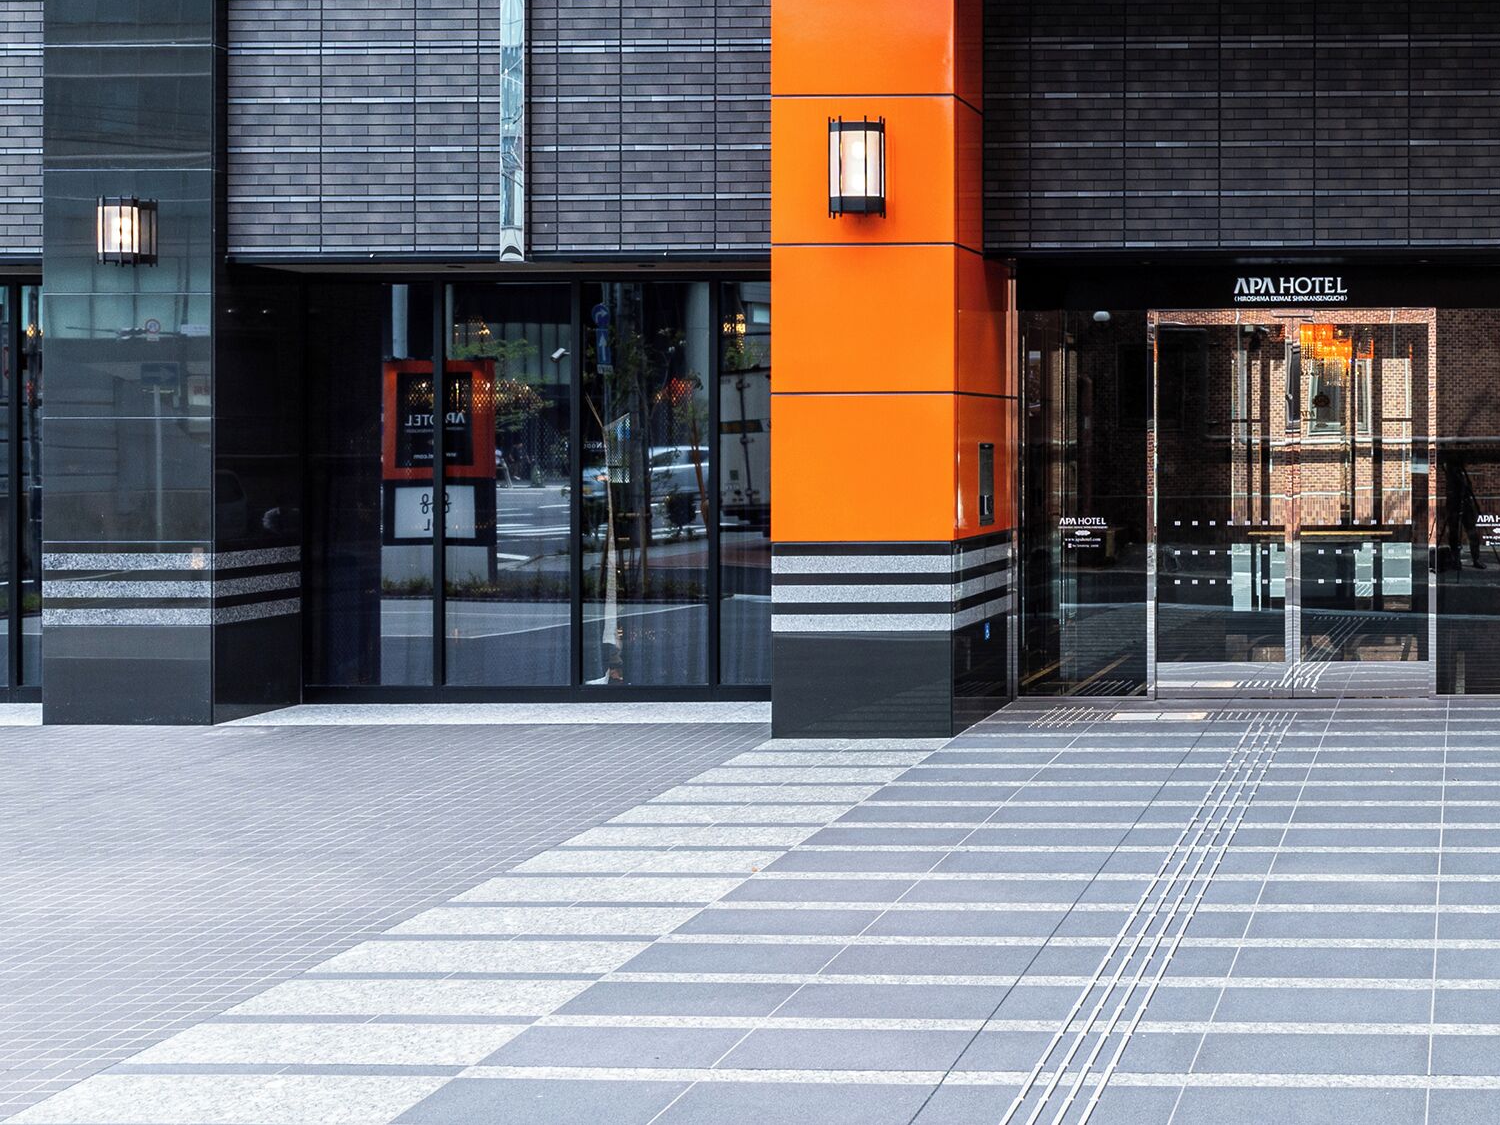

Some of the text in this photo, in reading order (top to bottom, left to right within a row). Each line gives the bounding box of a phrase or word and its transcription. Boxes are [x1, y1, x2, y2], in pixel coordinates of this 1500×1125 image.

[1234, 277, 1348, 294] APA HOTEL
[1059, 517, 1107, 525] APA HOTEL
[1476, 515, 1495, 523] APA
